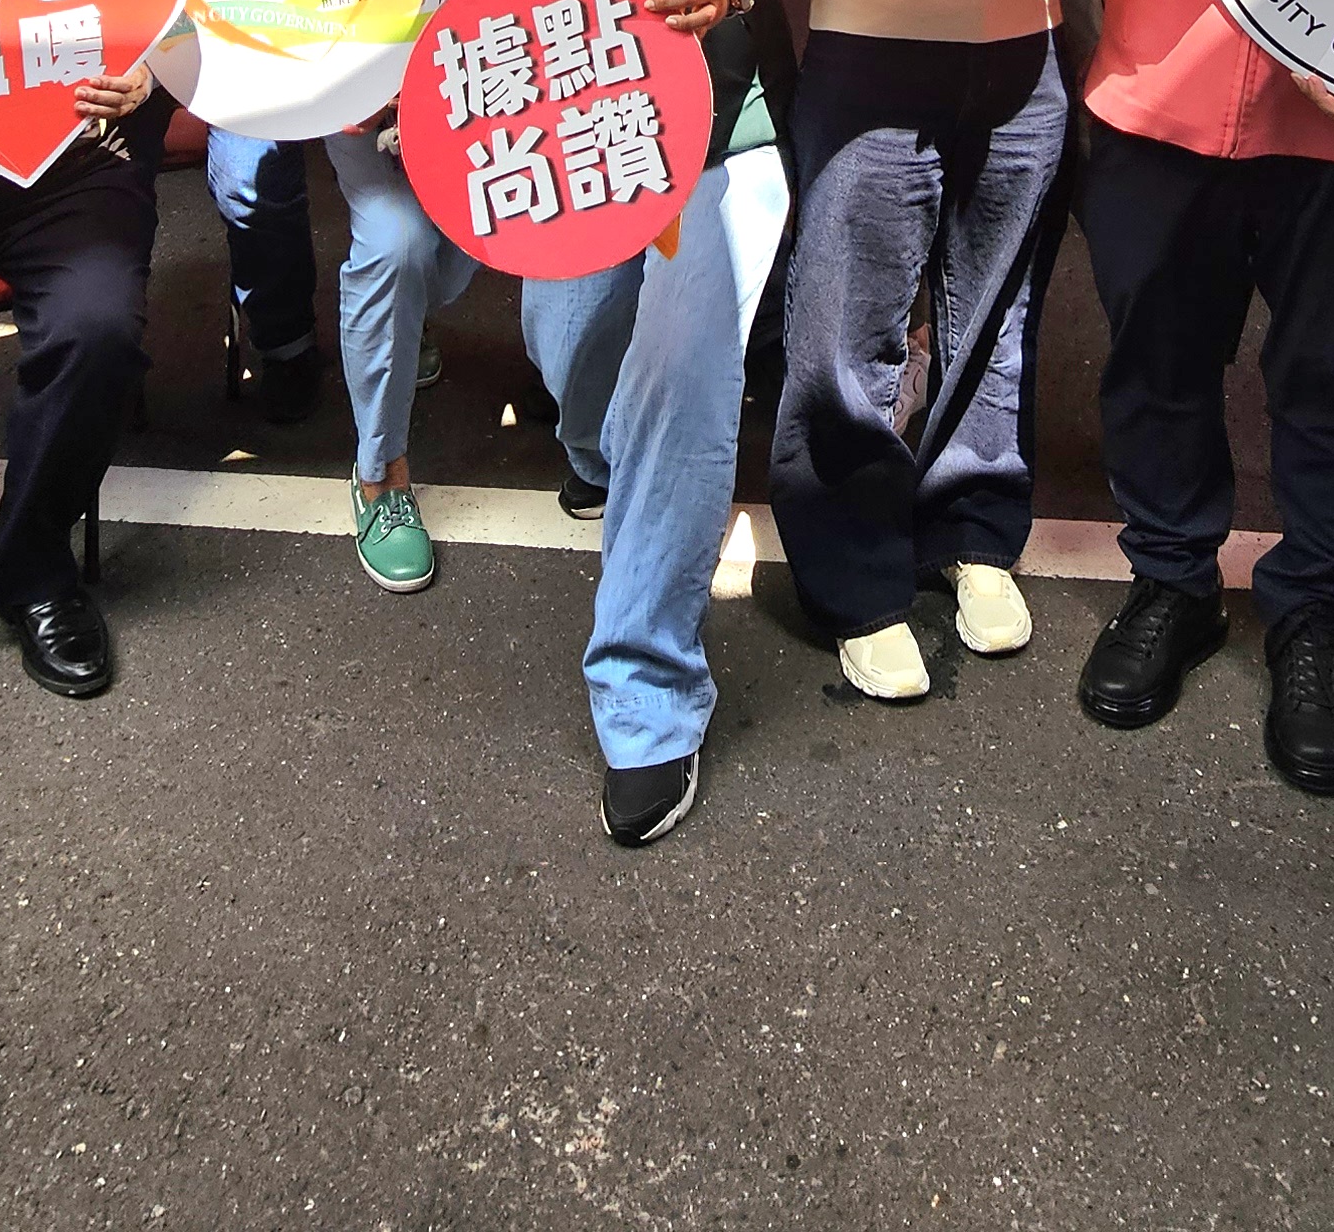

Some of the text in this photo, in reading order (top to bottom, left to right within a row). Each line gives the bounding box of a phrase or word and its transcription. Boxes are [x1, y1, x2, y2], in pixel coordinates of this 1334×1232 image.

[208, 5, 250, 22] CITY
[250, 8, 358, 37] GOVERNMENT
[467, 94, 670, 236] 尚讚
